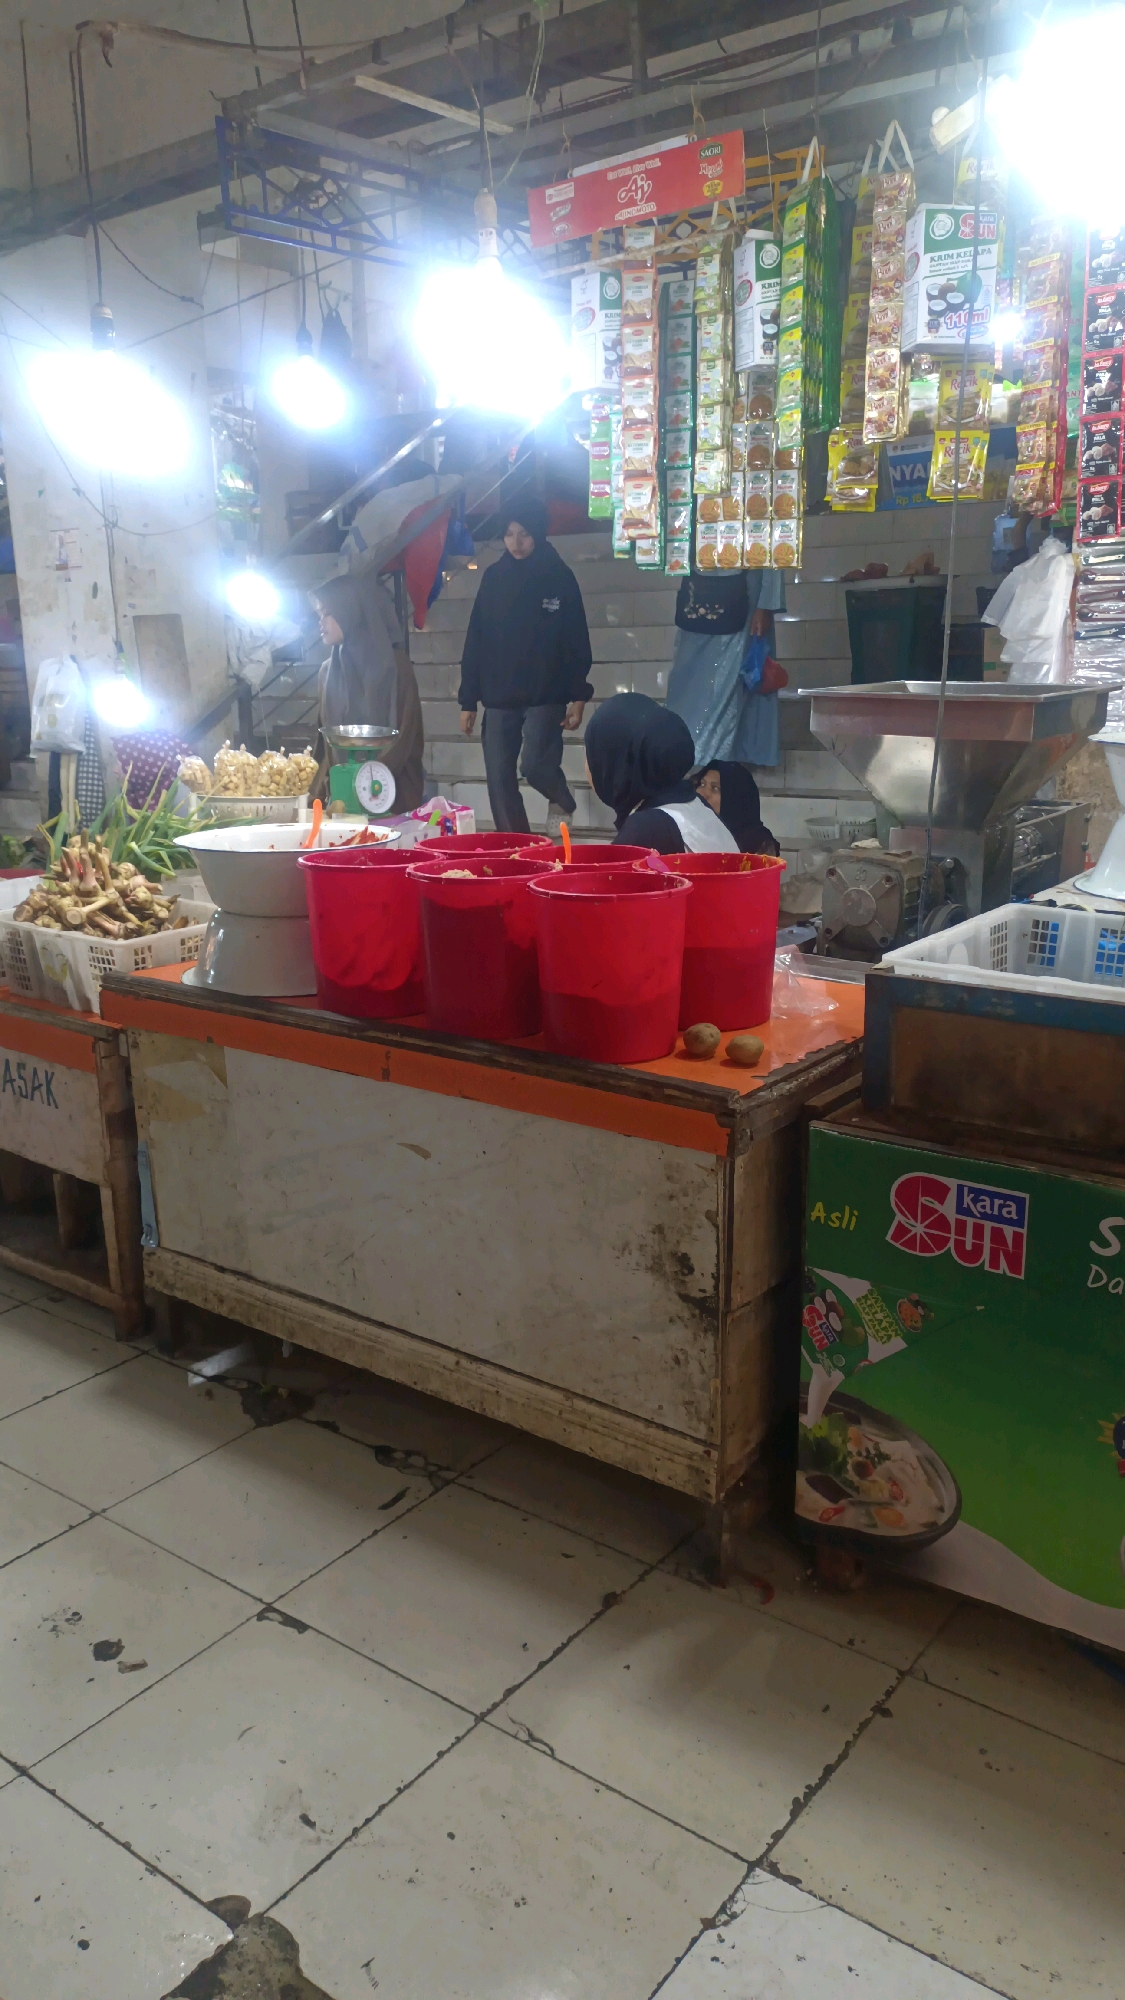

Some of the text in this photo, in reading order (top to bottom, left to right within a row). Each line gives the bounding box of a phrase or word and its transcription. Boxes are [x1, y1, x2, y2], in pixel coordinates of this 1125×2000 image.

[700, 146, 721, 158] SAORI
[615, 202, 657, 220] AJINOMOTO
[929, 253, 955, 264] KRIM
[810, 1202, 859, 1231] Asli
[962, 1187, 1019, 1220] kara
[886, 1171, 1026, 1280] SUN
[802, 1304, 829, 1351] SUN
[860, 1293, 896, 1342] KELAPA
[866, 1287, 904, 1339] SANTAN
[820, 1322, 837, 1344] kara
